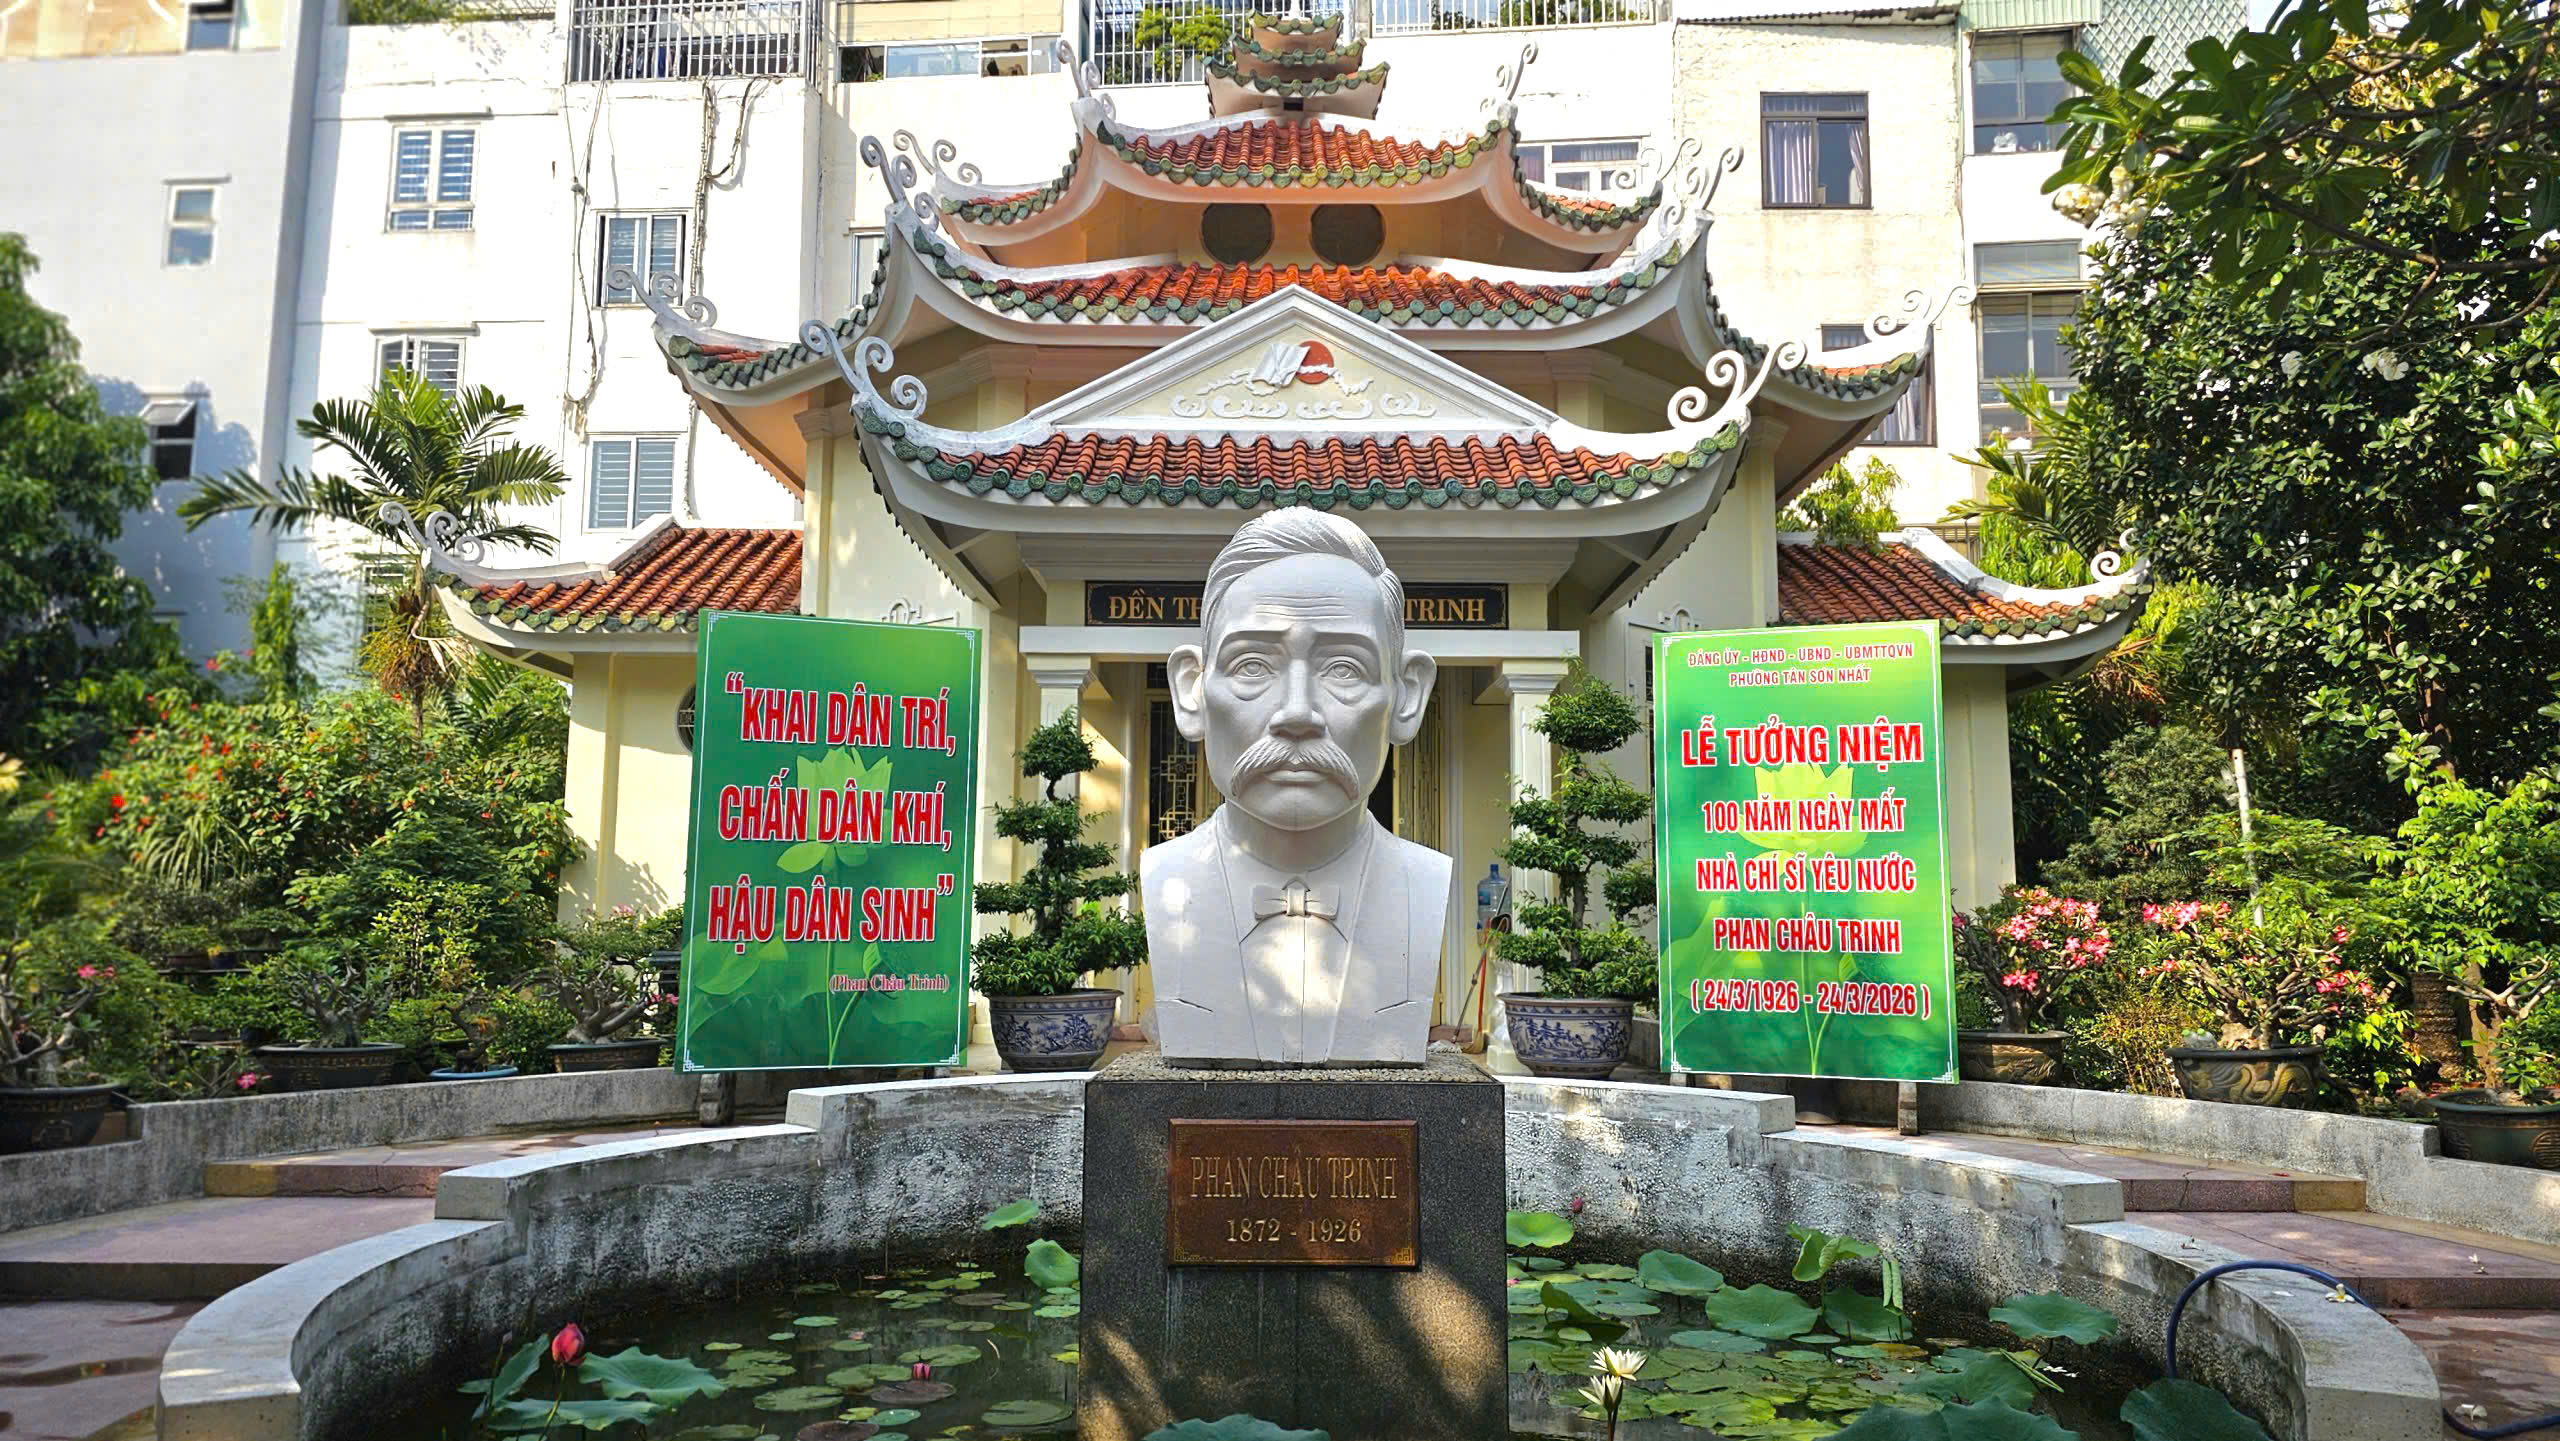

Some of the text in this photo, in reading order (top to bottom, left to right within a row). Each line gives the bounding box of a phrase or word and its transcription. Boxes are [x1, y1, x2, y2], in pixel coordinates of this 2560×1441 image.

[1108, 588, 1486, 622] ĐỀN TH TRINH
[1752, 649, 1785, 663] HĐND
[1798, 647, 1832, 661] UBND
[1845, 643, 1914, 660] UBMTTQVN
[1729, 665, 1871, 687] PHƯỜNG TÂN SƠN NHẤT
[826, 682, 893, 747] DÂN
[900, 687, 956, 756] TRÍ,
[1682, 714, 1924, 772] LỄ TƯỞNG NIỆM
[718, 768, 952, 852] CHẤN DÂN KHÍ,
[1702, 787, 1906, 833] 100 NĂM NGÀY MẤT
[1696, 852, 1917, 892] NHÀ CHÍ SĨ YÊU NƯỚC
[707, 874, 776, 954] HẬU
[784, 875, 852, 942] DÂN
[1713, 912, 1902, 953] PHAN CHÂU TRINH
[829, 974, 950, 993] (Phan Châu Trinh)
[1190, 1147, 1398, 1199] PHAN CHÂU TRINH
[1226, 1218, 1281, 1242] 1872
[1308, 1218, 1362, 1242] 1926
